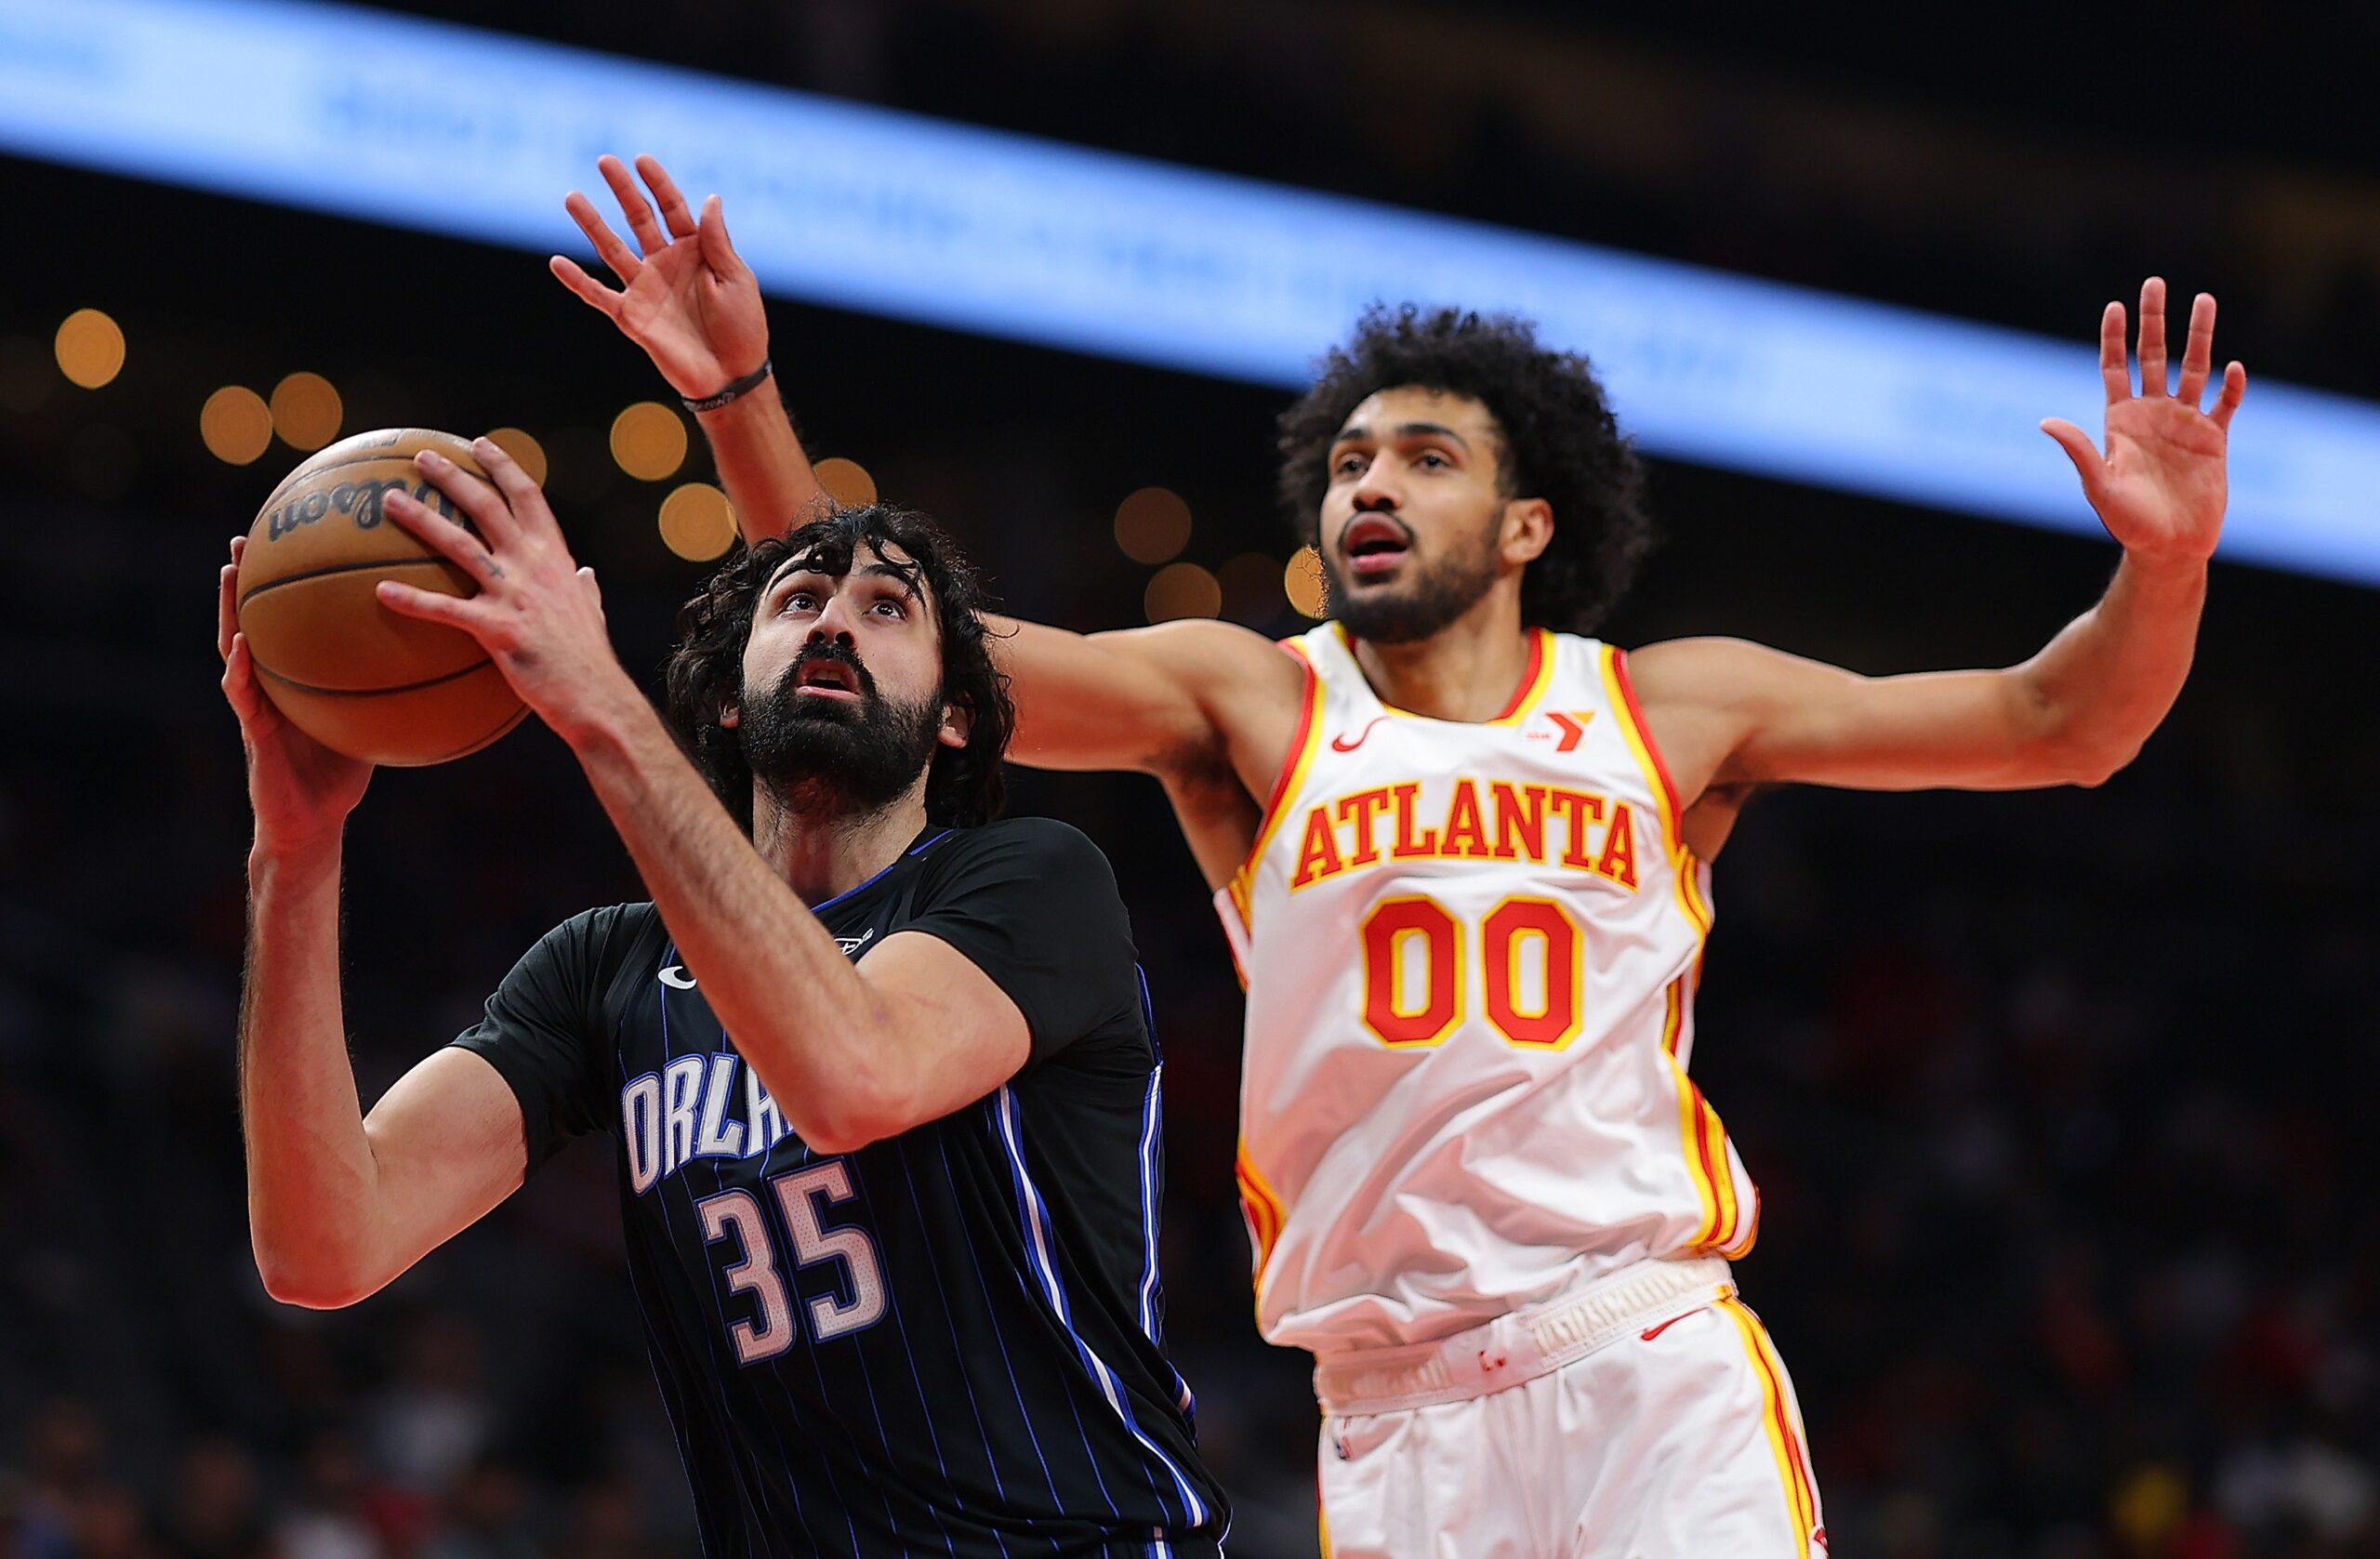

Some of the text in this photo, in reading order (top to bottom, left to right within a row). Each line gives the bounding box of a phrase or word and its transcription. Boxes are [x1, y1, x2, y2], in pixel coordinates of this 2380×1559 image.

[1289, 777, 1639, 893] ATLANTA
[1360, 894, 1583, 1051] 00
[622, 1051, 800, 1197] ORLA
[694, 1156, 891, 1369] 35
